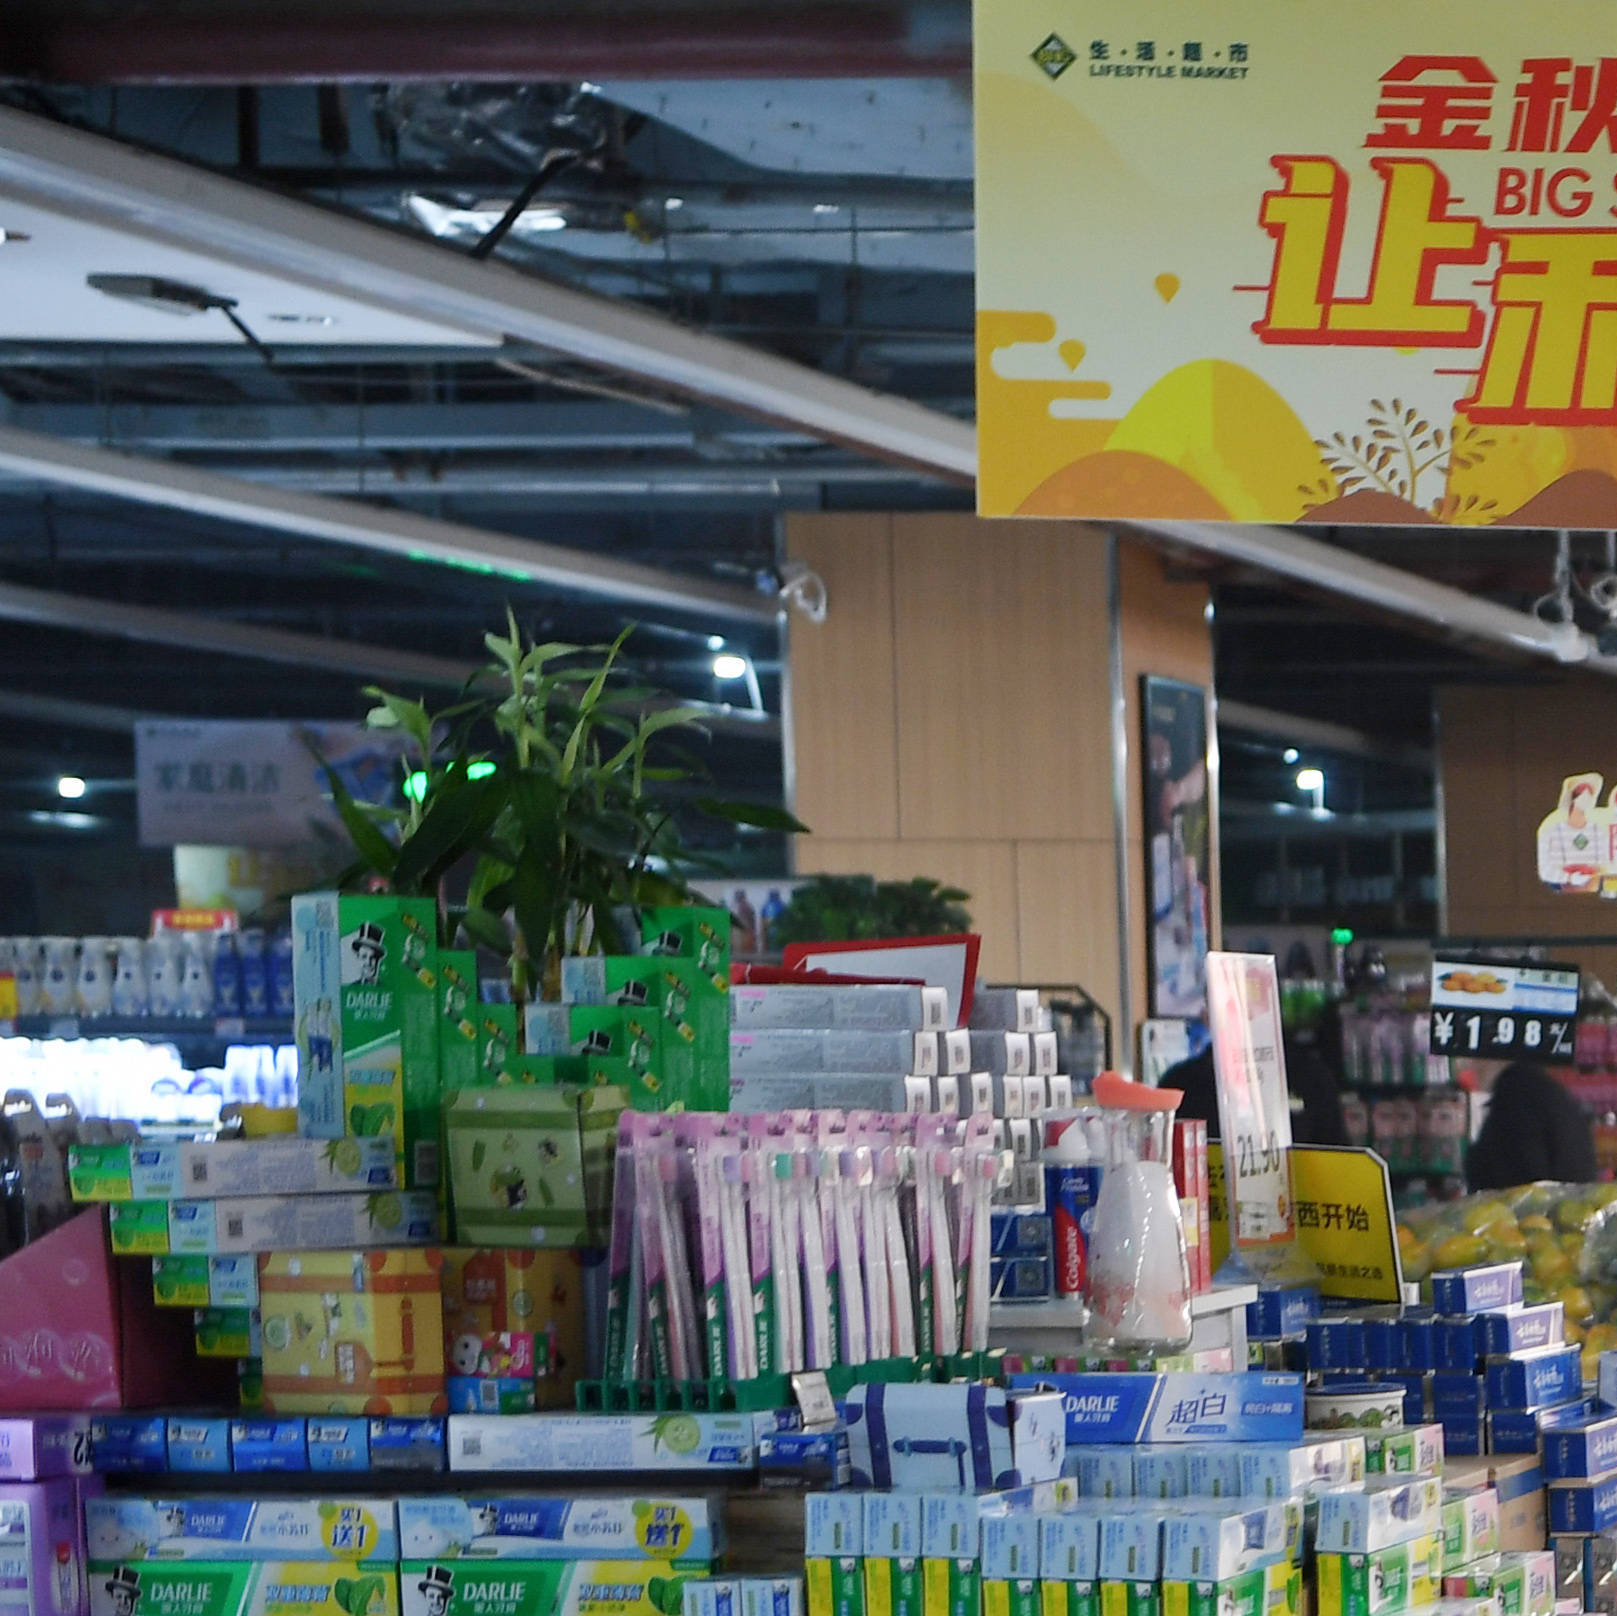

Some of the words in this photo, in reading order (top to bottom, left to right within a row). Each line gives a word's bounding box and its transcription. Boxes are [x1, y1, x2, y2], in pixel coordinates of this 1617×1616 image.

[1089, 64, 1177, 78] LIFESTYLE
[1180, 65, 1250, 79] MARKET
[1494, 167, 1594, 220] BIG
[1065, 1225, 1080, 1291] Colgate
[1065, 1395, 1120, 1413] DARLIE
[1165, 1390, 1228, 1426] 超白
[340, 1506, 362, 1522] 买1
[654, 1506, 677, 1521] 买1
[332, 1524, 369, 1548] 送1
[646, 1524, 684, 1547] 送1
[149, 1581, 214, 1602] DARLIE
[463, 1581, 527, 1602] DARLIE
